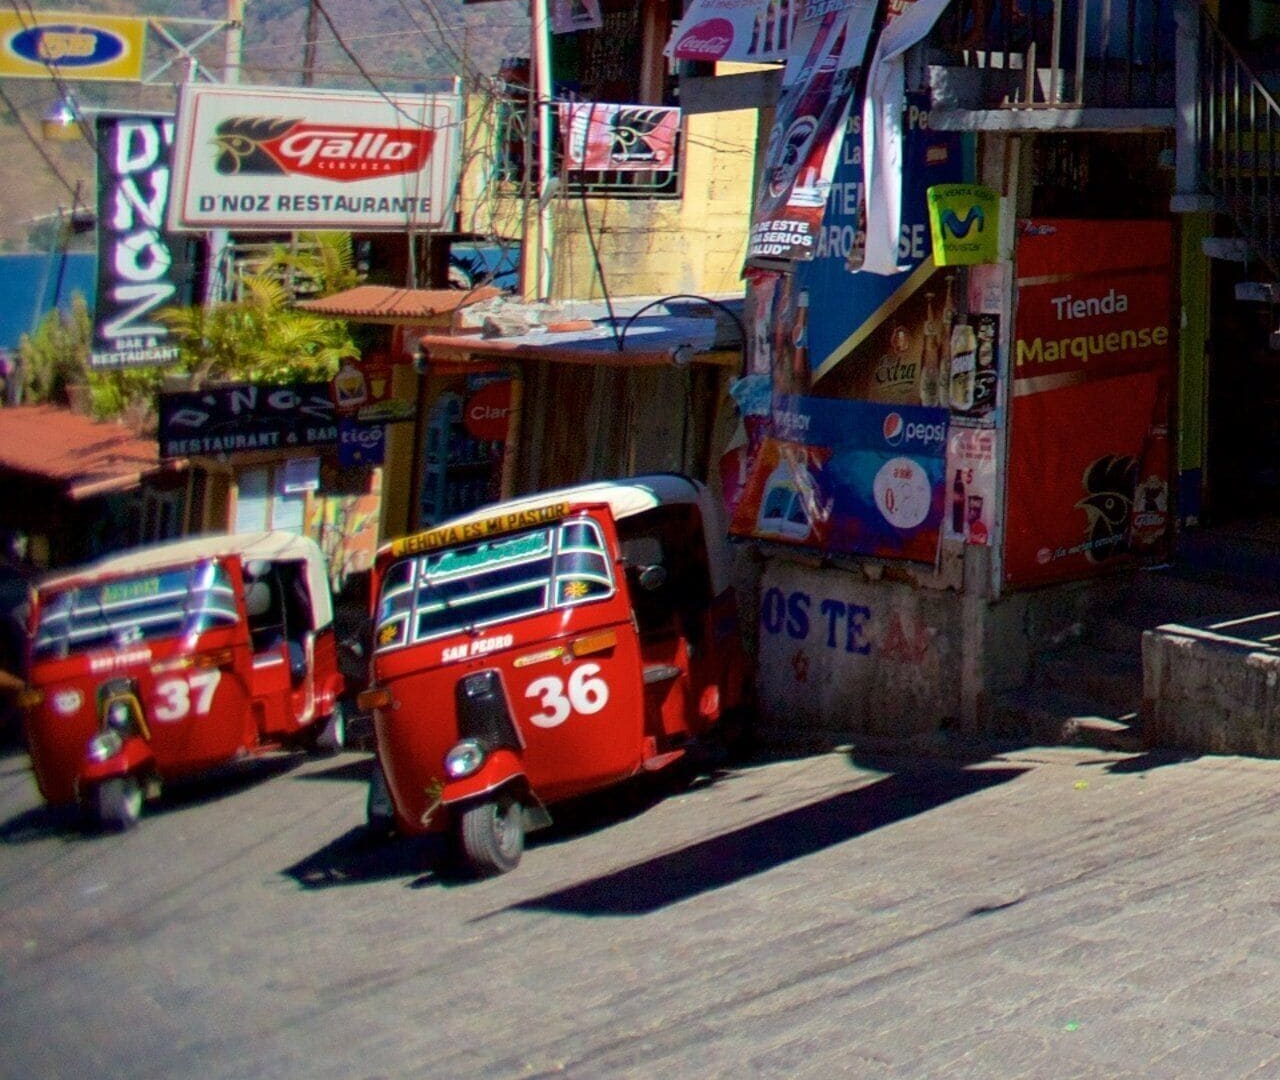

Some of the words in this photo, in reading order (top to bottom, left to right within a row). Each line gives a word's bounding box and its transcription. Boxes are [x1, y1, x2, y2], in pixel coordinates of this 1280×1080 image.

[280, 130, 413, 167] Gallo
[318, 161, 391, 170] CERVEZA
[277, 195, 431, 214] RESTAURANTE
[763, 232, 812, 246] SERIOS
[772, 220, 809, 233] ESTE
[1051, 290, 1128, 320] Tienda
[1016, 325, 1169, 366] Marquense
[905, 421, 945, 440] pepsi
[463, 522, 483, 536] ES
[507, 504, 566, 527] PASTOR
[441, 644, 470, 663] SAN
[471, 634, 514, 655] PEDRO
[154, 668, 222, 722] 37
[525, 663, 610, 728] 36
